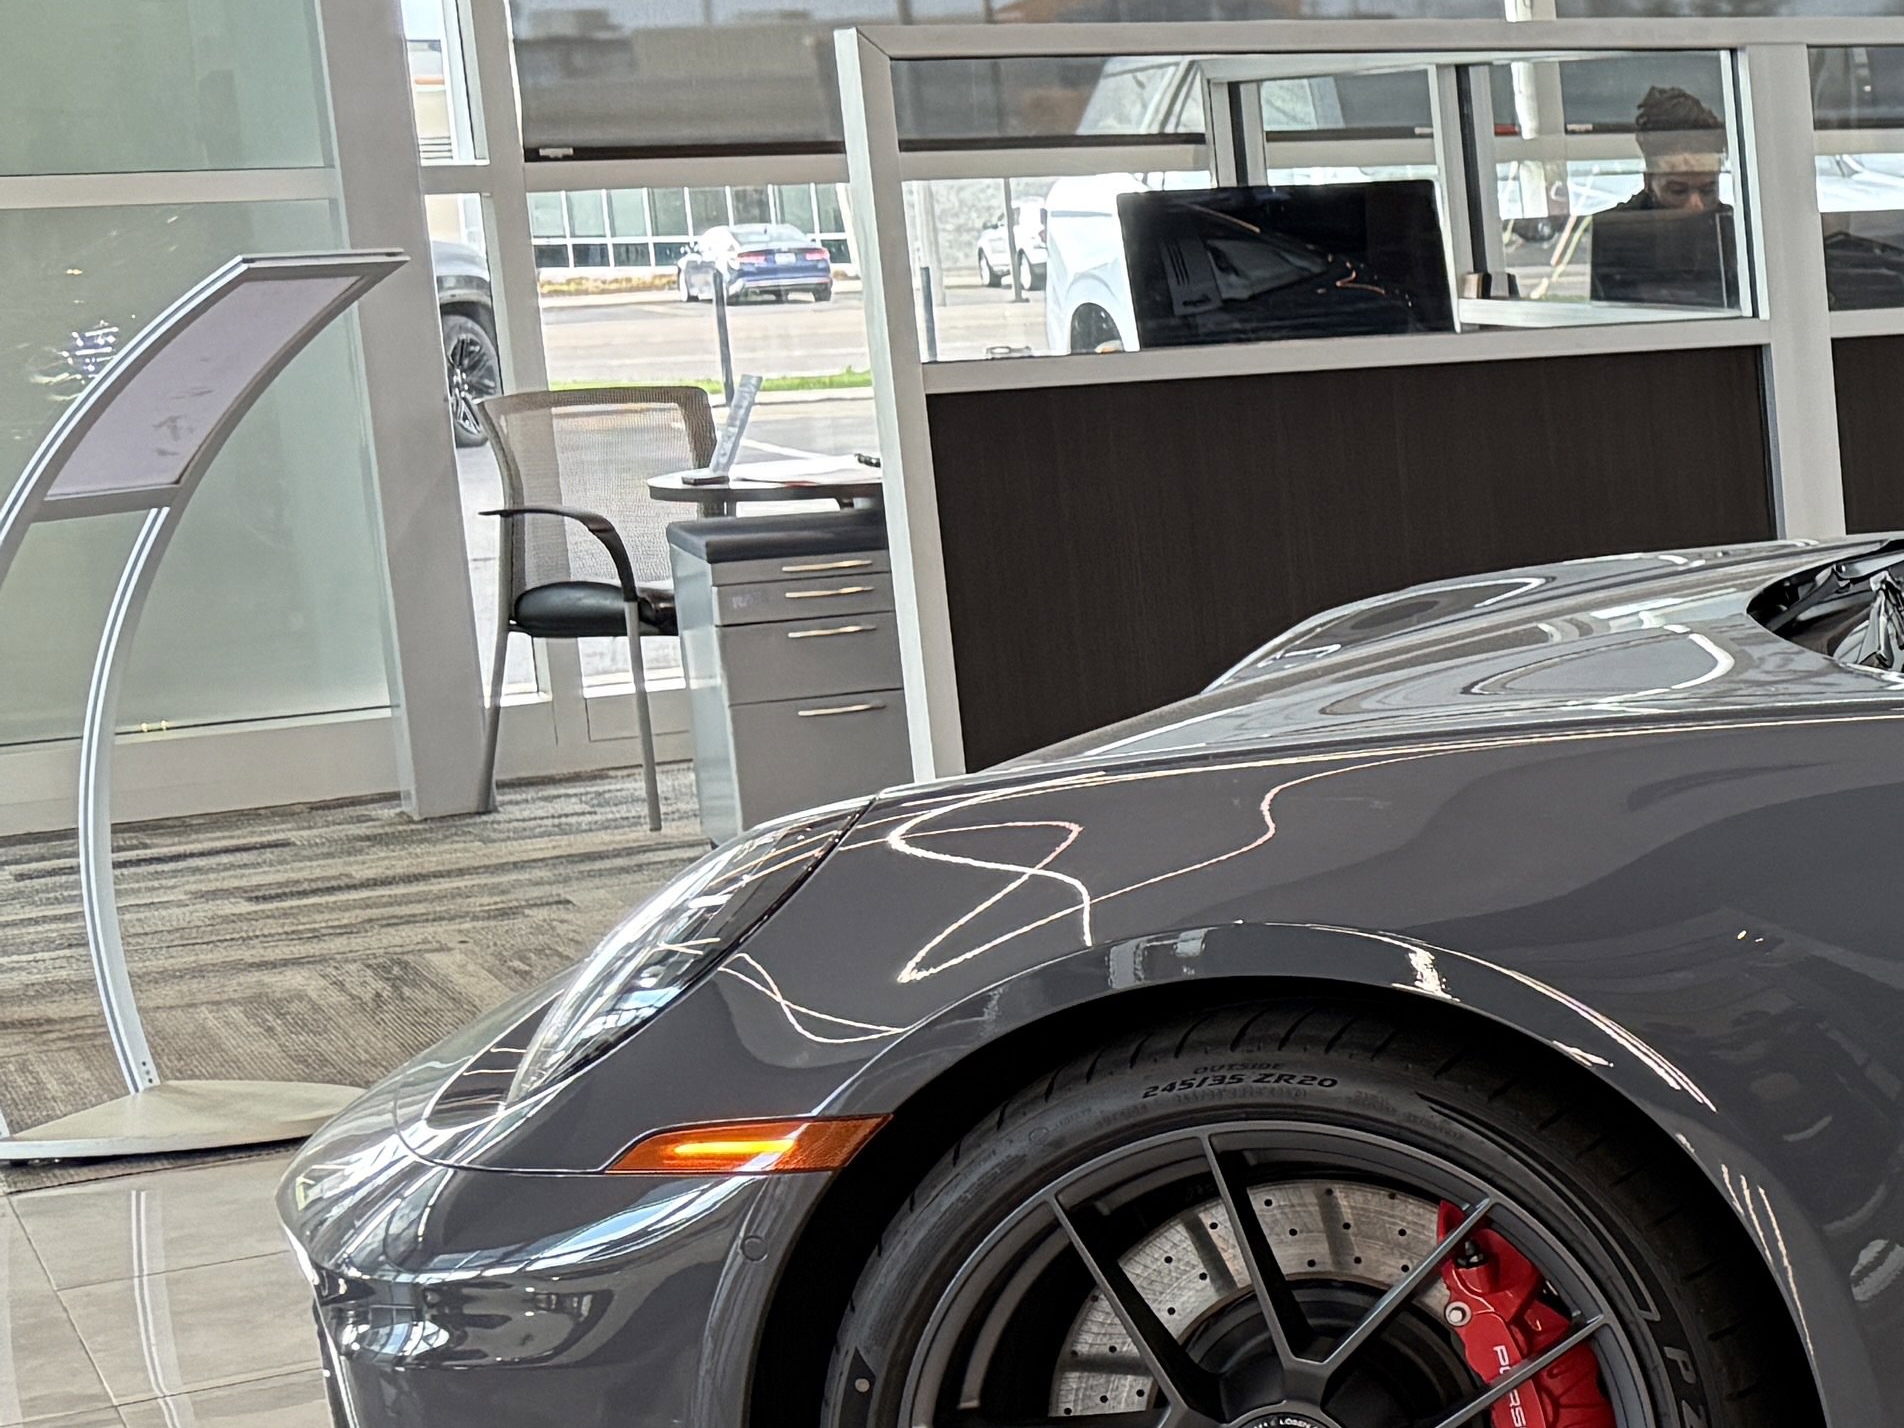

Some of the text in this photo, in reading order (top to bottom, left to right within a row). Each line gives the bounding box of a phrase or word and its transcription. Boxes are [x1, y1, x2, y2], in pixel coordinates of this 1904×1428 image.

[1194, 1062, 1286, 1074] OUTSIDE
[1142, 1073, 1245, 1099] 245/35
[1664, 1346, 1697, 1384] P
